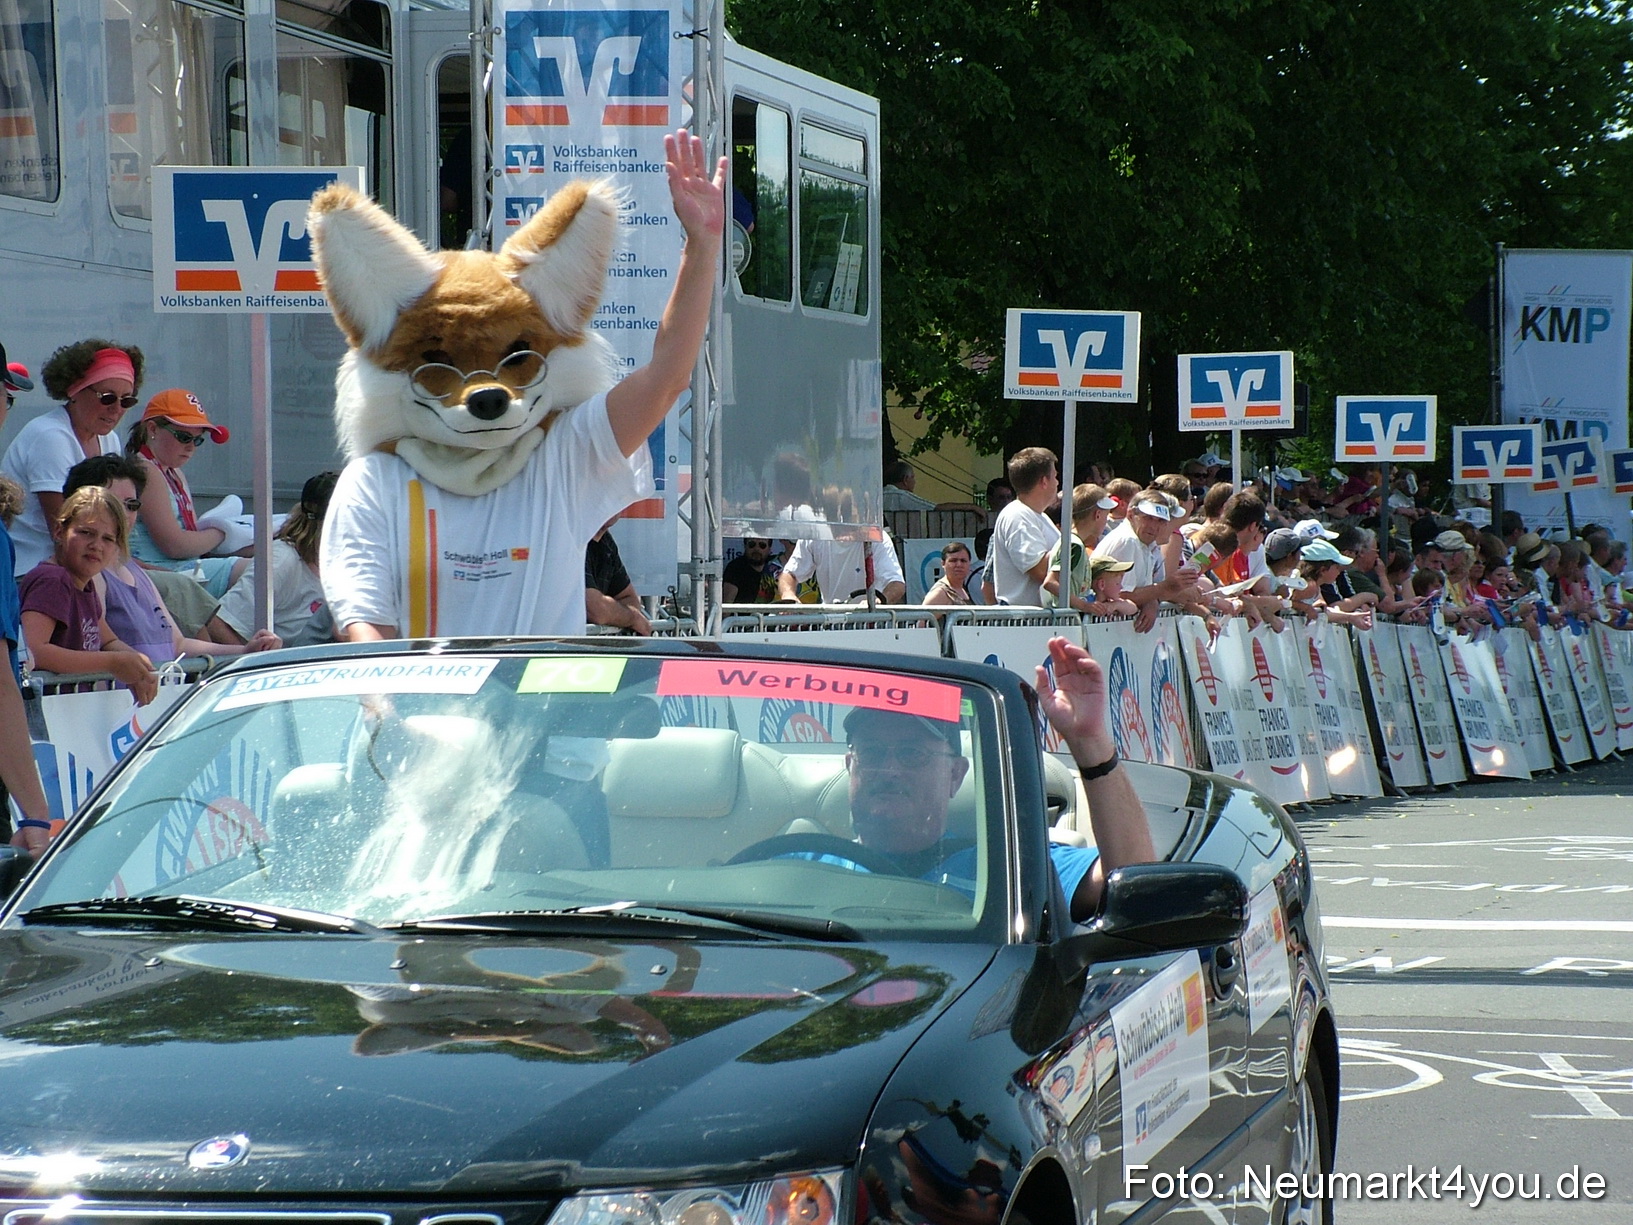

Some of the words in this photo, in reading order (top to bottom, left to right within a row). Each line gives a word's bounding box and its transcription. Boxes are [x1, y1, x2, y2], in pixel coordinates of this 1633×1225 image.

[552, 144, 637, 158] Volksbanken
[160, 295, 242, 308] Volksbanken
[246, 295, 328, 308] Raiffeisenba
[1521, 305, 1611, 344] KMP
[1008, 387, 1060, 397] Volksbanken
[1061, 388, 1133, 399] Raiffeisenbanken
[1182, 418, 1228, 427] Volksbanken
[1228, 417, 1291, 426] Raiffeisenbanken
[490, 548, 508, 560] Hall
[540, 662, 604, 685] 70
[717, 669, 909, 706] Werbung
[1258, 707, 1291, 732] FRANKEN
[1314, 703, 1341, 728] FRANKEN
[1457, 697, 1487, 718] FRANKEN
[1204, 710, 1235, 737] FRANKEN
[1264, 734, 1297, 759] BRUNNEN
[1120, 1000, 1169, 1070] Schwäbisch
[1166, 986, 1185, 1034] Hall
